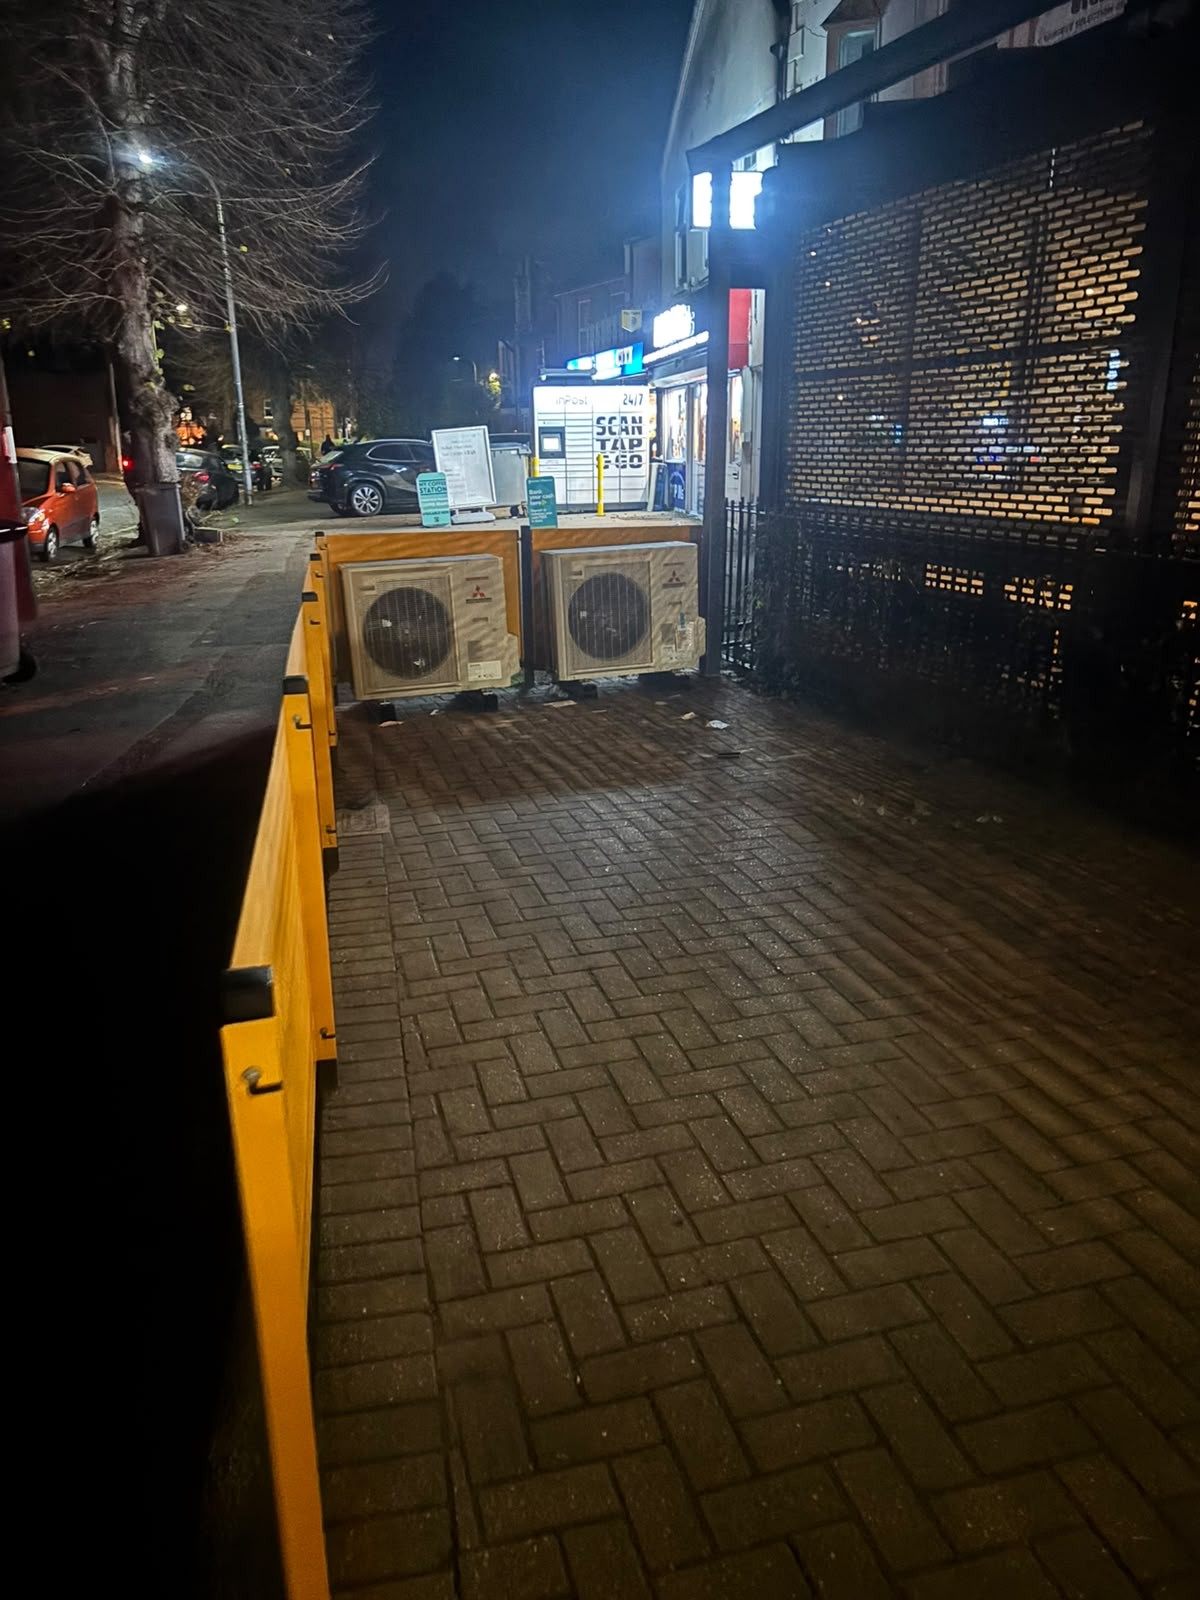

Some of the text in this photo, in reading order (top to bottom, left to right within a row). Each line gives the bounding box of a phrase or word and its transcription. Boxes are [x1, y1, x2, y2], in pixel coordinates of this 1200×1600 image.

[623, 393, 644, 406] 24/7
[596, 416, 643, 436] SCAN
[595, 438, 643, 453] TAP
[614, 454, 643, 469] GO
[419, 486, 447, 494] STATION
